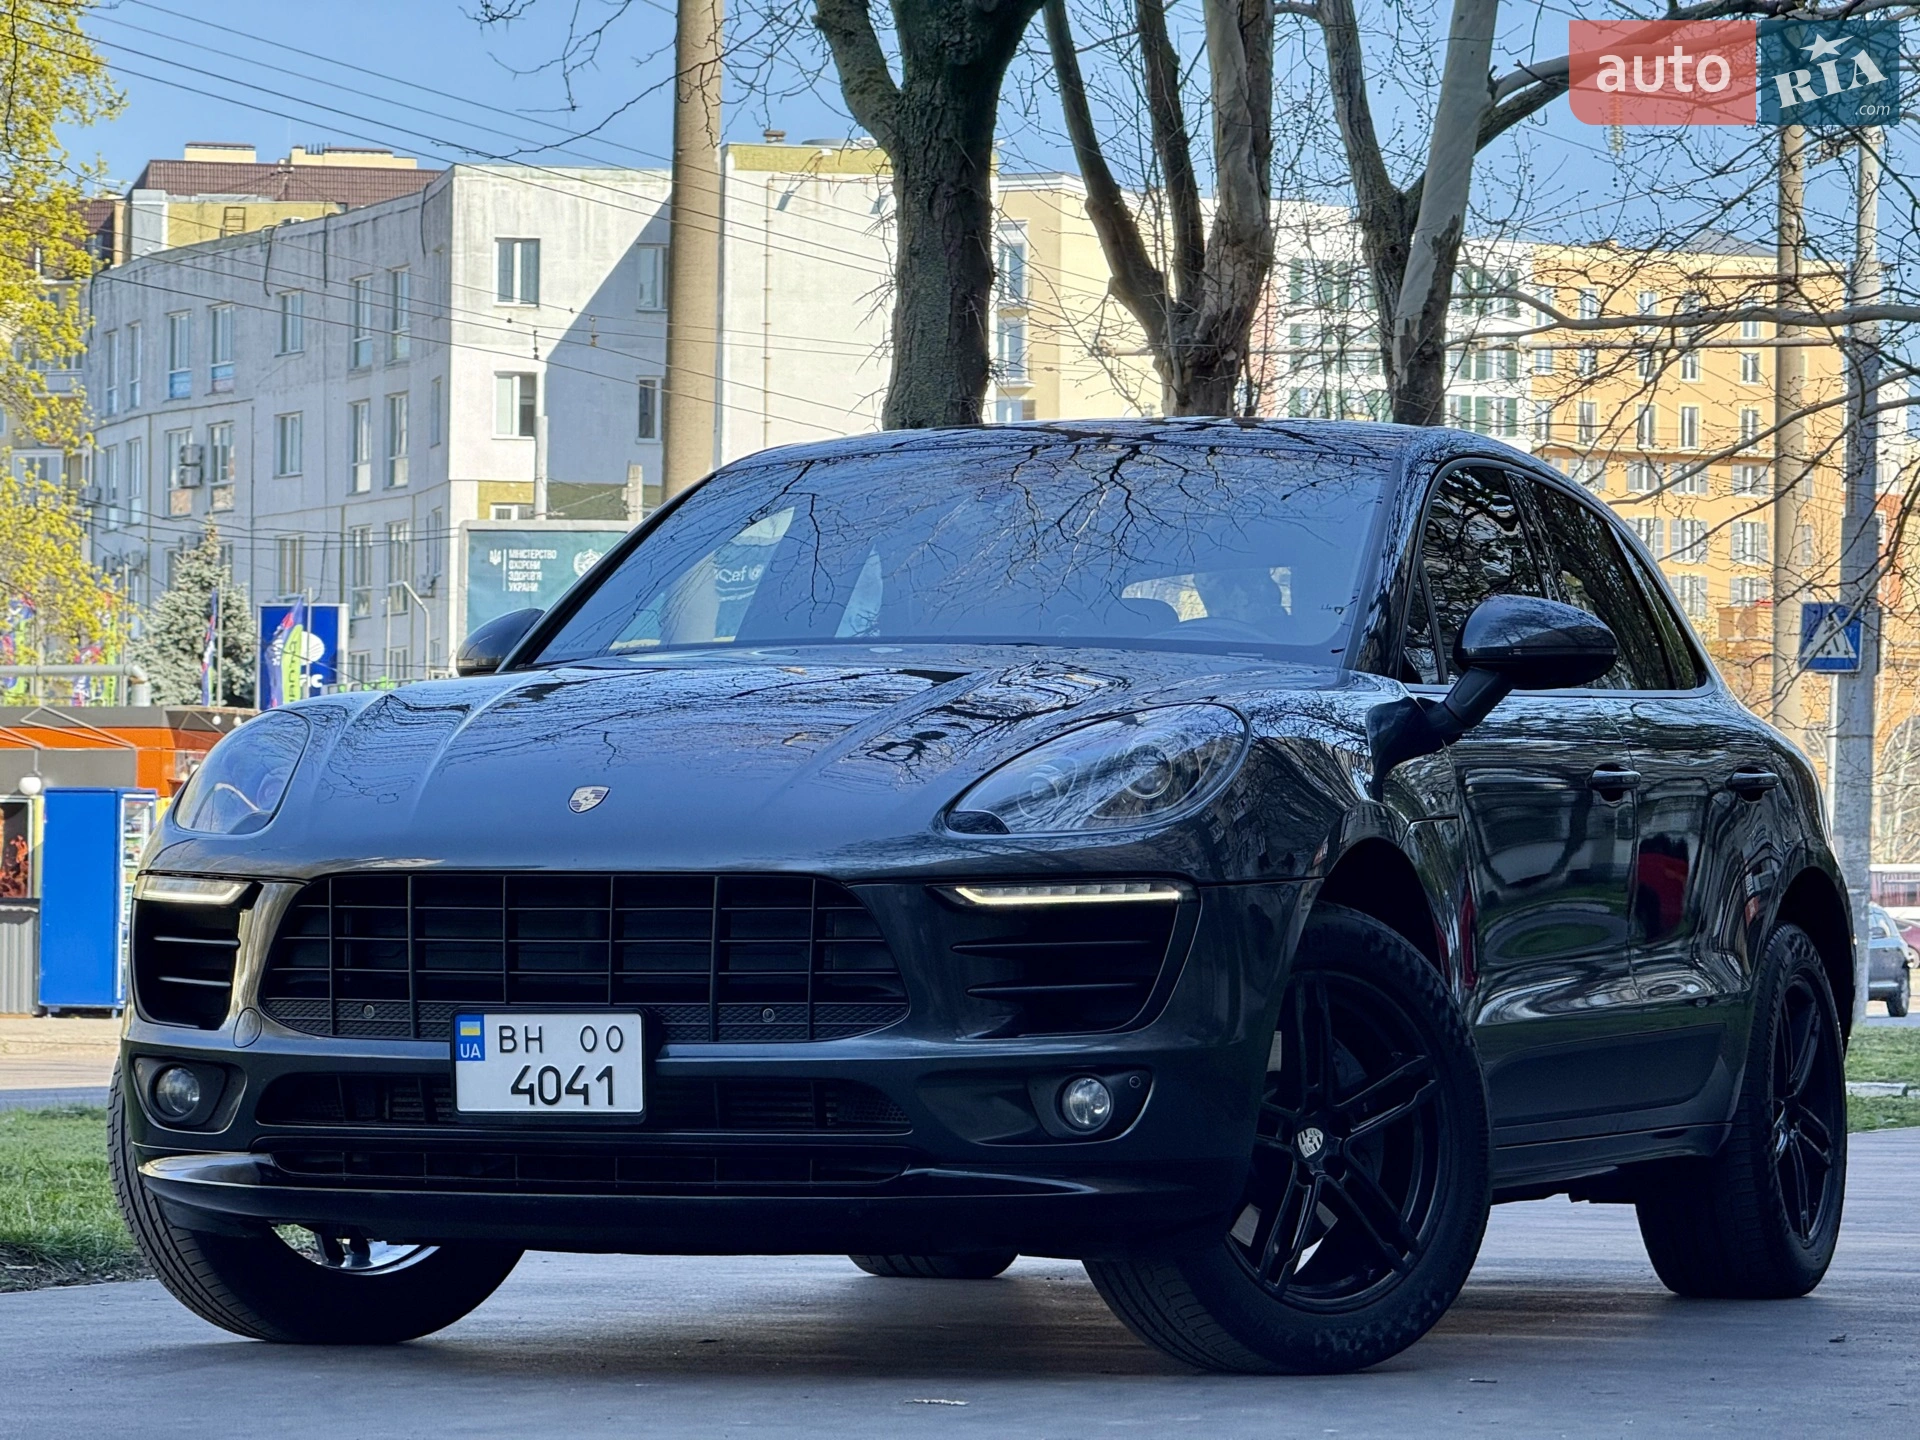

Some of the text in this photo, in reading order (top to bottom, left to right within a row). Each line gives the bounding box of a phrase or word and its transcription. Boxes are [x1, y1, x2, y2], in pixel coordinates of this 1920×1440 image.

[508, 549, 557, 560] МІНІСТЕРСТВО
[508, 560, 541, 570] ОХОРОНИ
[508, 581, 539, 592] УКРАЇНИ
[498, 1025, 543, 1053] BH
[460, 1043, 481, 1058] UA
[511, 1065, 614, 1106] 4041
